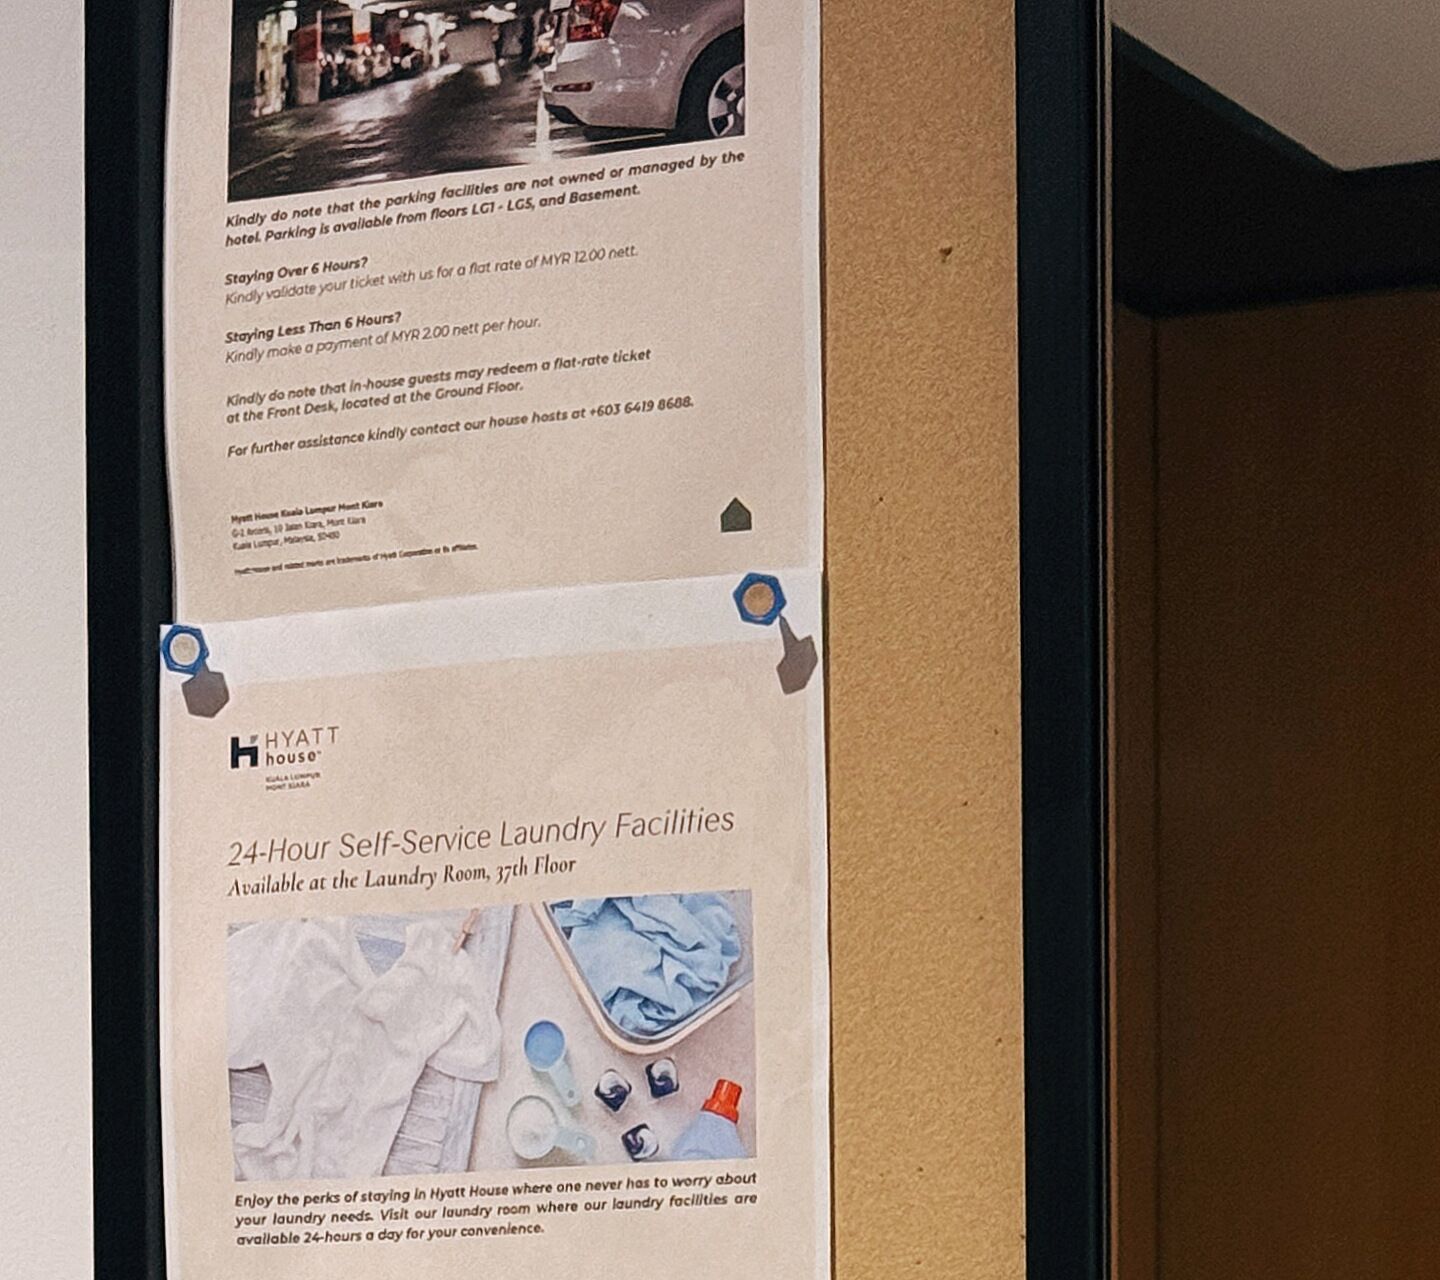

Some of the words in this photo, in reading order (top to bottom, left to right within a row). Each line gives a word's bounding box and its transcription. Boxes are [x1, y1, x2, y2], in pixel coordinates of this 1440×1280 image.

[225, 212, 267, 228] Kindly
[270, 209, 288, 222] do
[291, 206, 322, 219] note
[326, 201, 355, 215] that
[359, 197, 381, 210] the
[384, 190, 436, 210] parking
[440, 182, 499, 199] facilities
[503, 180, 527, 192] are
[531, 175, 554, 189] not
[558, 167, 606, 185] owned
[609, 167, 624, 178] or
[627, 156, 695, 176] managed
[699, 155, 718, 169] by
[721, 151, 745, 164] the
[264, 225, 317, 242] Parking
[319, 222, 330, 235] is
[332, 214, 393, 233] available
[395, 211, 427, 225] from
[430, 206, 468, 220] floors
[471, 201, 495, 215] LG1
[538, 192, 566, 207] and
[568, 184, 640, 204] Basement.
[224, 269, 274, 286] Staying
[277, 266, 309, 279] Over
[310, 262, 319, 275] 6
[322, 256, 368, 273] Hours?
[224, 327, 275, 344] Staying
[277, 325, 305, 337] Less
[308, 320, 341, 333] Than
[344, 316, 353, 329] 6
[355, 311, 402, 328] Hours?
[226, 391, 266, 407] Kindly
[268, 389, 285, 402] do
[287, 386, 316, 400] note
[319, 382, 346, 396] that
[349, 377, 405, 392] in-house
[407, 370, 451, 388] guests
[454, 367, 485, 381] may
[486, 362, 538, 377] redeem
[540, 361, 551, 371] a
[553, 353, 609, 370] flat-rate
[612, 348, 651, 363] ticket
[265, 726, 339, 749] HYATT
[227, 837, 331, 866] 24-Hour
[338, 824, 491, 858] Self-Service
[500, 816, 607, 847] Laundry
[615, 807, 734, 838] Facilities
[227, 874, 304, 896] Available
[308, 877, 326, 890] at
[332, 870, 358, 889] the
[364, 865, 437, 890] Laundry
[443, 864, 491, 883] Room,
[496, 857, 528, 884] 37th
[534, 855, 577, 875] Floor
[234, 1193, 274, 1209] Enjoy
[276, 1193, 300, 1205] the
[302, 1191, 340, 1208] perks
[343, 1190, 359, 1203] of
[360, 1188, 410, 1204] staying
[413, 1187, 426, 1200] in
[429, 1187, 466, 1202] Hyatt
[469, 1185, 509, 1197] House
[511, 1182, 553, 1195] where
[556, 1182, 582, 1193] one
[584, 1180, 623, 1191] never
[625, 1177, 650, 1190] has
[653, 1176, 668, 1188] to
[671, 1175, 712, 1189] worry
[715, 1172, 757, 1185] about
[234, 1215, 267, 1229] your
[272, 1211, 326, 1226] laundry
[380, 1207, 409, 1221] Visit
[414, 1209, 437, 1219] our
[441, 1204, 493, 1219] laundry
[496, 1204, 531, 1216] room
[536, 1200, 578, 1213] where
[583, 1200, 608, 1211] our
[612, 1195, 664, 1211] laundry
[669, 1192, 728, 1207] facilities
[734, 1194, 758, 1204] are
[236, 1231, 300, 1245] available
[303, 1230, 362, 1244] 24-hours
[365, 1231, 374, 1241] a
[377, 1228, 403, 1243] day
[405, 1227, 425, 1239] for
[426, 1228, 457, 1241] your
[460, 1221, 544, 1237] convenience.
